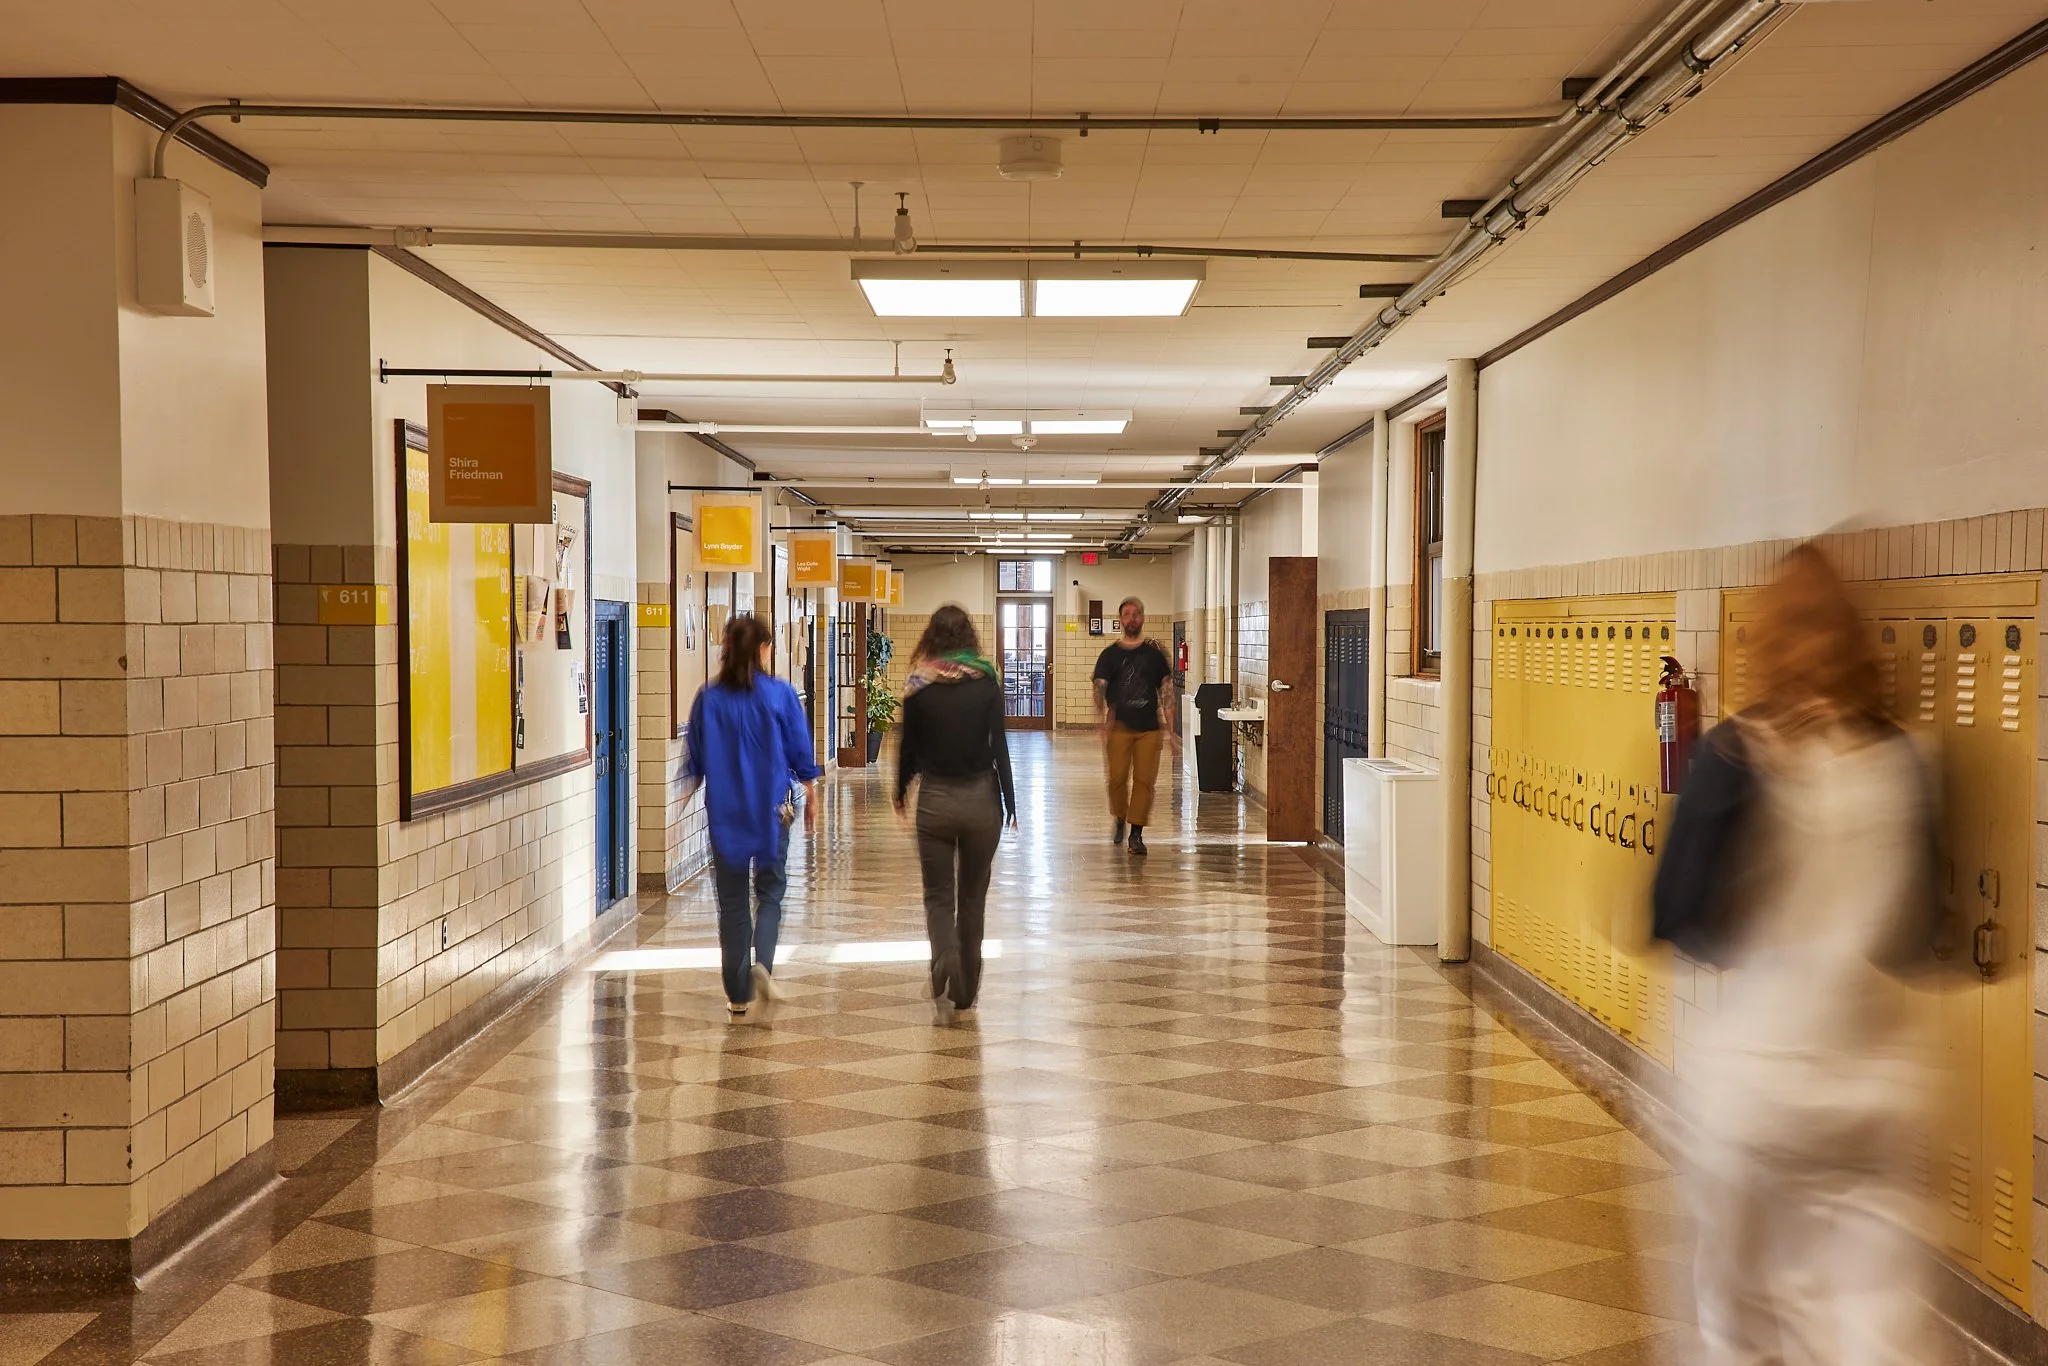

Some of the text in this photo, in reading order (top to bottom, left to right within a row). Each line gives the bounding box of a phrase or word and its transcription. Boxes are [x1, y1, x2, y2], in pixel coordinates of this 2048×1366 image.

[448, 456, 479, 468] Shira
[448, 469, 504, 480] Friedman
[703, 542, 744, 551] Lynn Snyder
[339, 589, 369, 604] 611
[645, 606, 663, 616] 611
